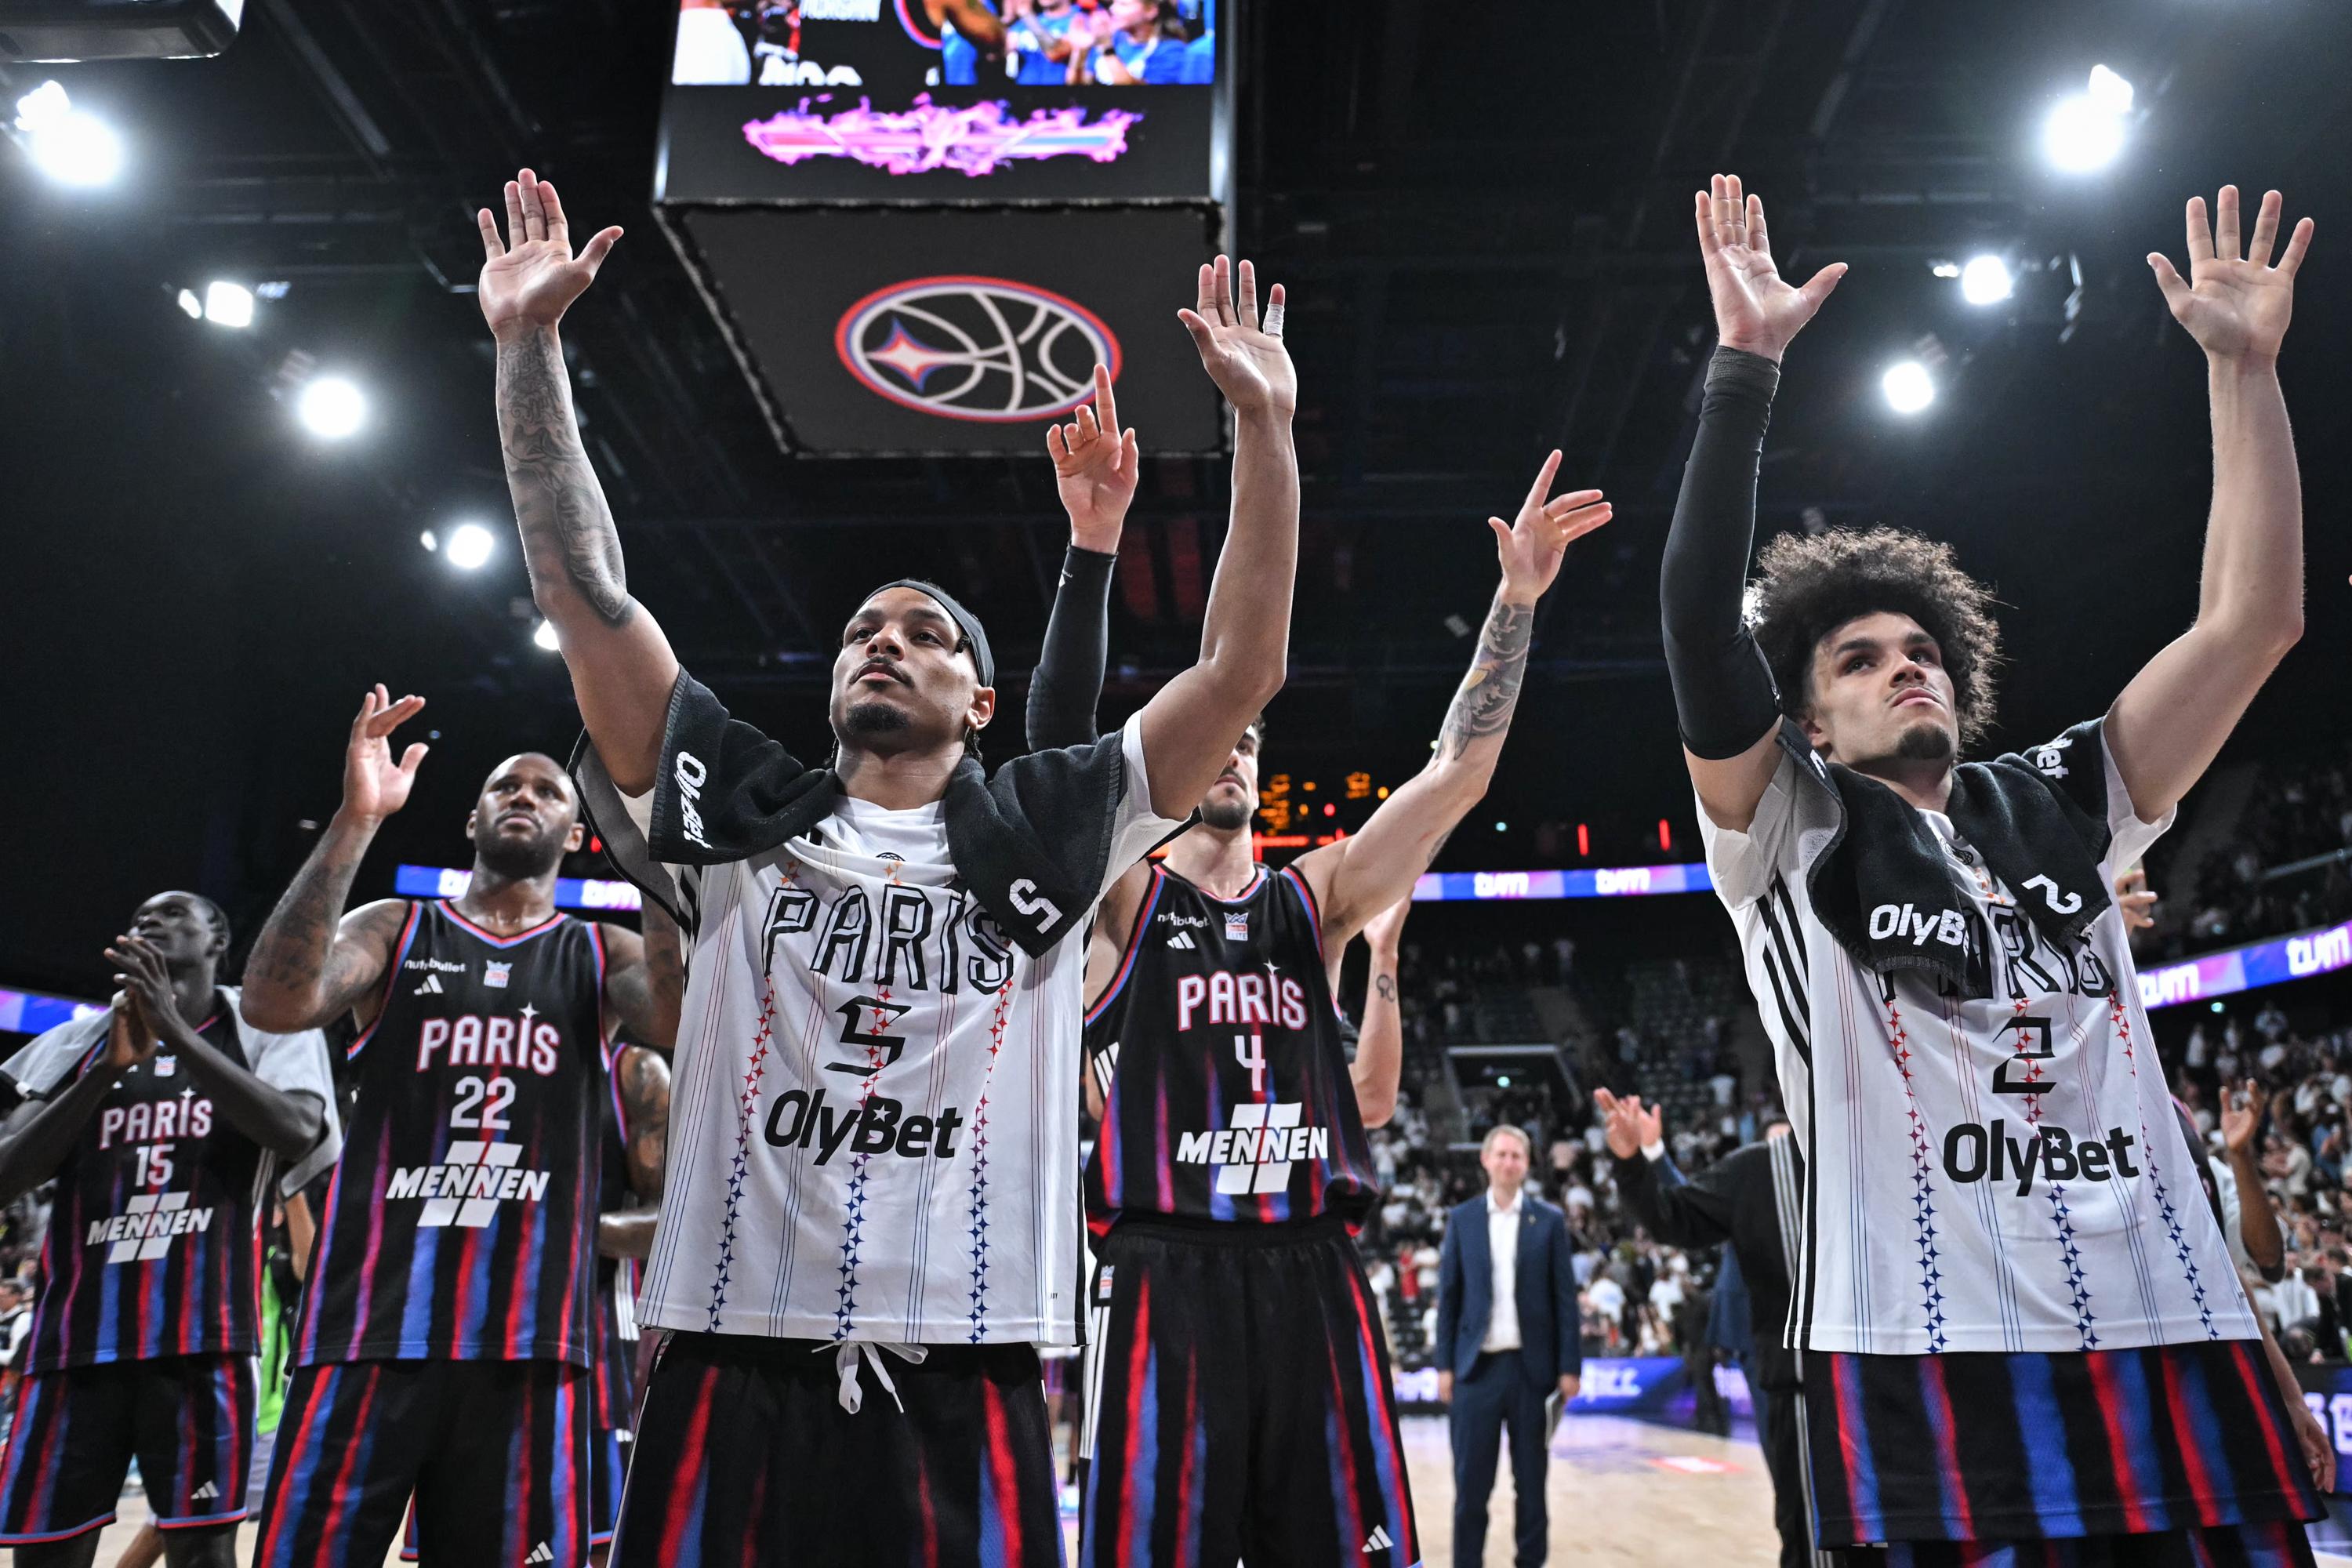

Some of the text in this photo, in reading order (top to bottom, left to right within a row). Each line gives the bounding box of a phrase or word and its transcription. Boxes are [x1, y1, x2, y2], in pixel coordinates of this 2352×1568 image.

[1009, 878, 1063, 935] 5
[2023, 873, 2082, 916] 2
[760, 884, 1014, 995] PARIS
[1869, 903, 1966, 946] OlyB
[1178, 971, 1308, 1031] PARIS
[416, 1016, 560, 1075] PARIS
[824, 995, 911, 1076] 5
[1236, 1035, 1265, 1091] 4
[1992, 1017, 2056, 1094] 2
[100, 1098, 212, 1149] PARIS
[450, 1076, 517, 1131] 22
[764, 1088, 963, 1165] OlyBet
[136, 1144, 174, 1187] 15
[1176, 1126, 1328, 1164] MENNEN
[1943, 1120, 2140, 1196] OlyBet
[386, 1166, 550, 1202] MENNEN
[86, 1207, 214, 1246] MENNEN
